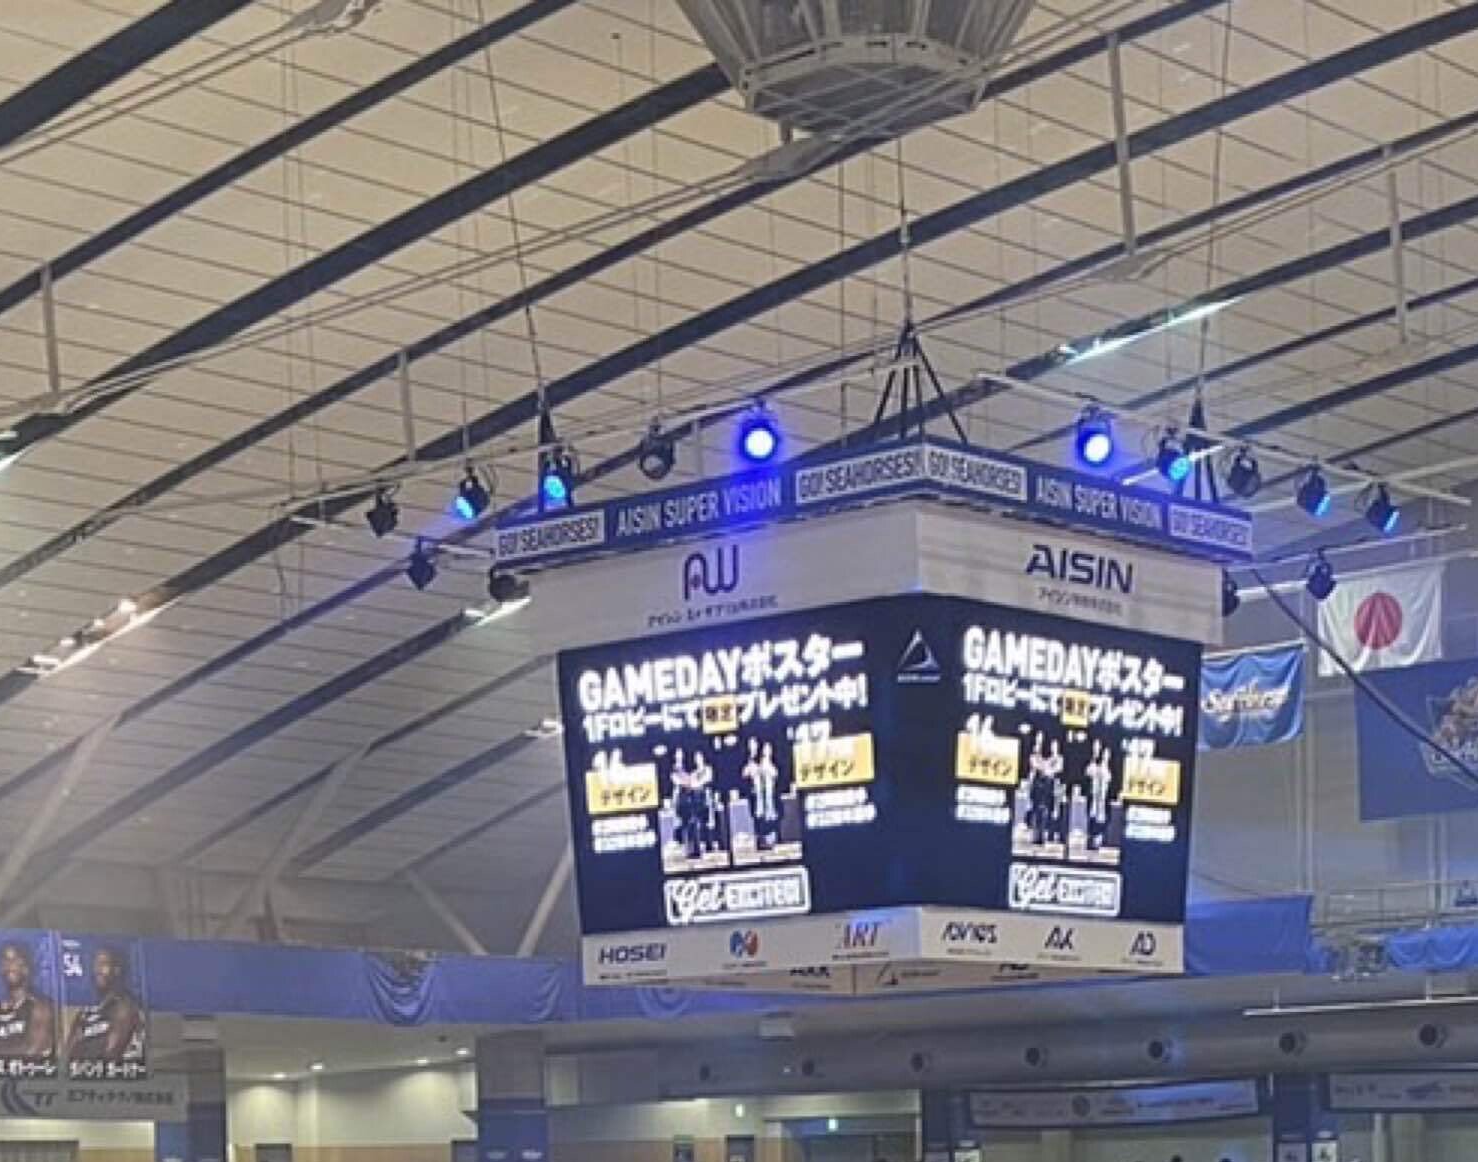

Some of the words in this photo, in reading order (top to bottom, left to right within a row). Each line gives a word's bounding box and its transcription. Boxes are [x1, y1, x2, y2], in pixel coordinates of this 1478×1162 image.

[616, 506, 660, 537] AISIN
[662, 492, 720, 528] SUPER
[721, 478, 782, 517] VISION
[1074, 485, 1117, 519] SUPER
[1026, 544, 1134, 594] AISIN
[578, 633, 865, 711] GAMEDAYポスター
[962, 625, 1185, 698] GAMEDAYポスター
[798, 761, 855, 782] デザイン
[599, 787, 651, 807] デザイン
[597, 942, 668, 966] HOSEI
